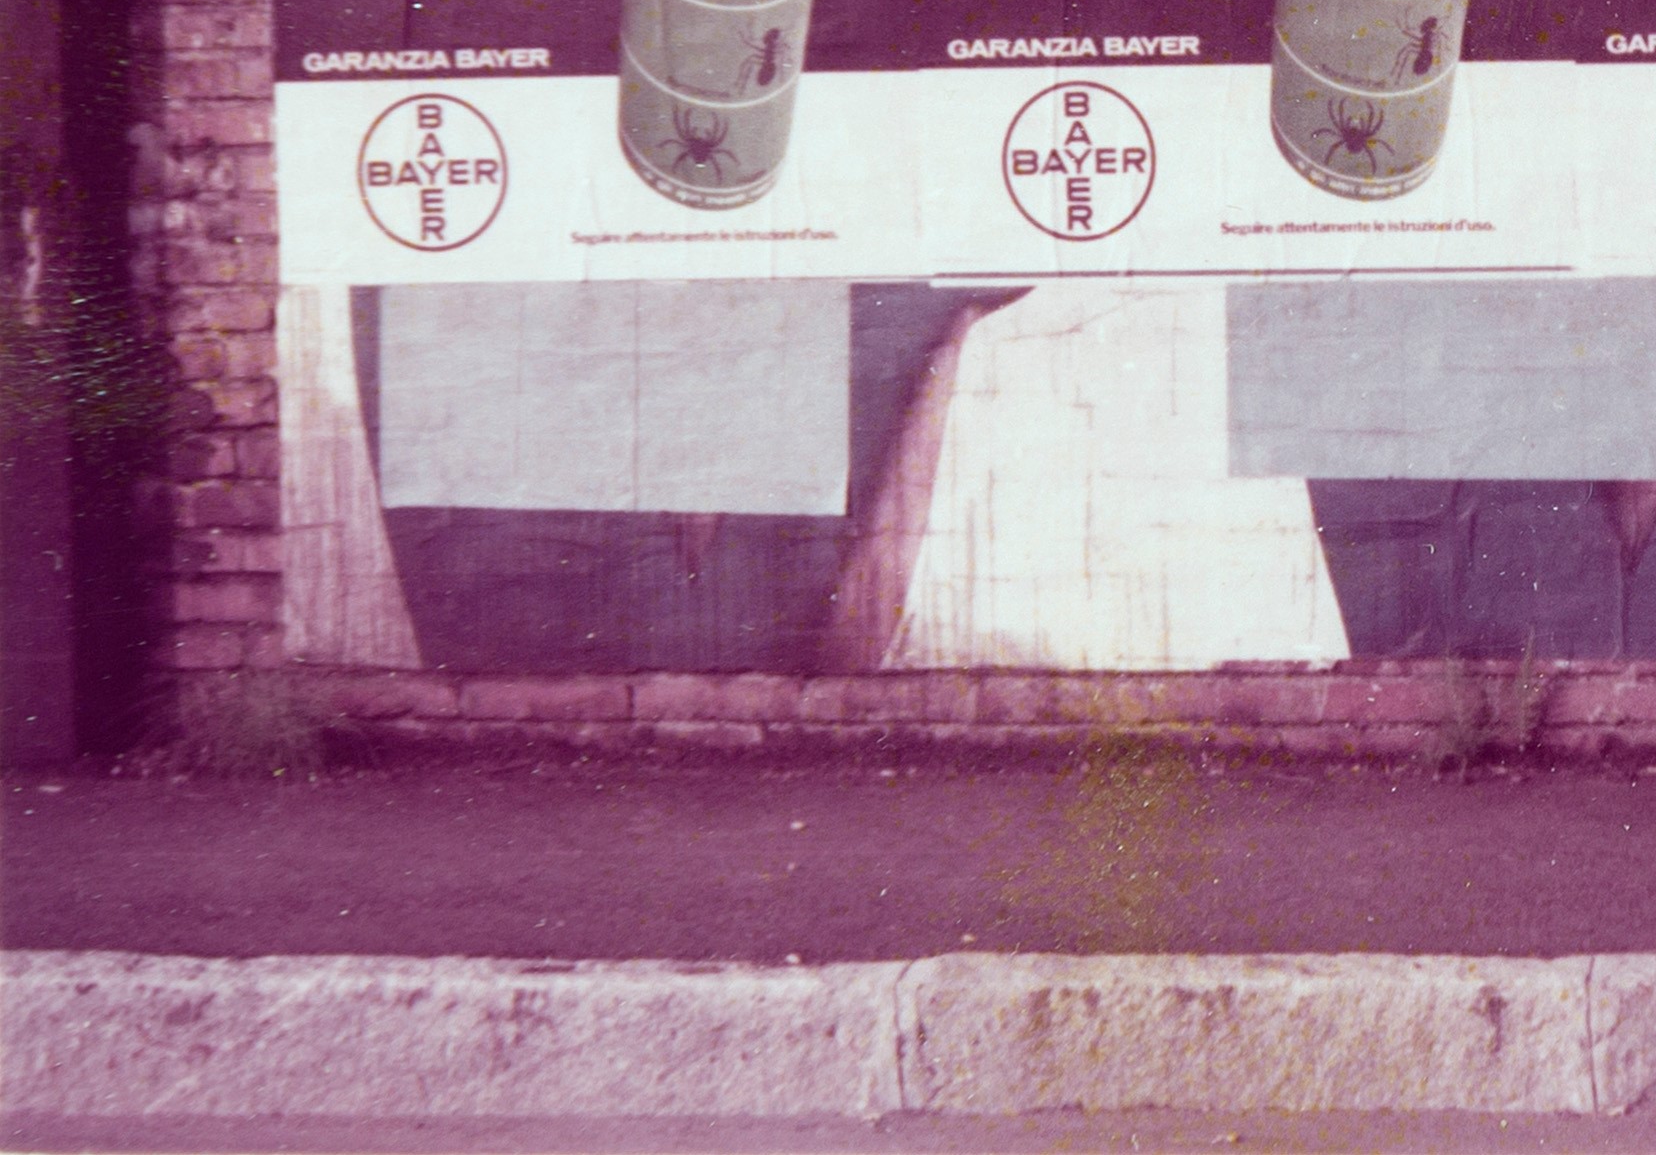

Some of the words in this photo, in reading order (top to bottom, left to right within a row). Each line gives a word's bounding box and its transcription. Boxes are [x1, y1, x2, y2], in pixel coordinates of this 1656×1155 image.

[947, 37, 1097, 59] GARANZIA
[1103, 35, 1199, 56] BAYER
[303, 50, 449, 72] GARANZIA
[454, 48, 550, 69] BAYER
[367, 159, 499, 186] BAYER
[1012, 147, 1146, 175] BAYER
